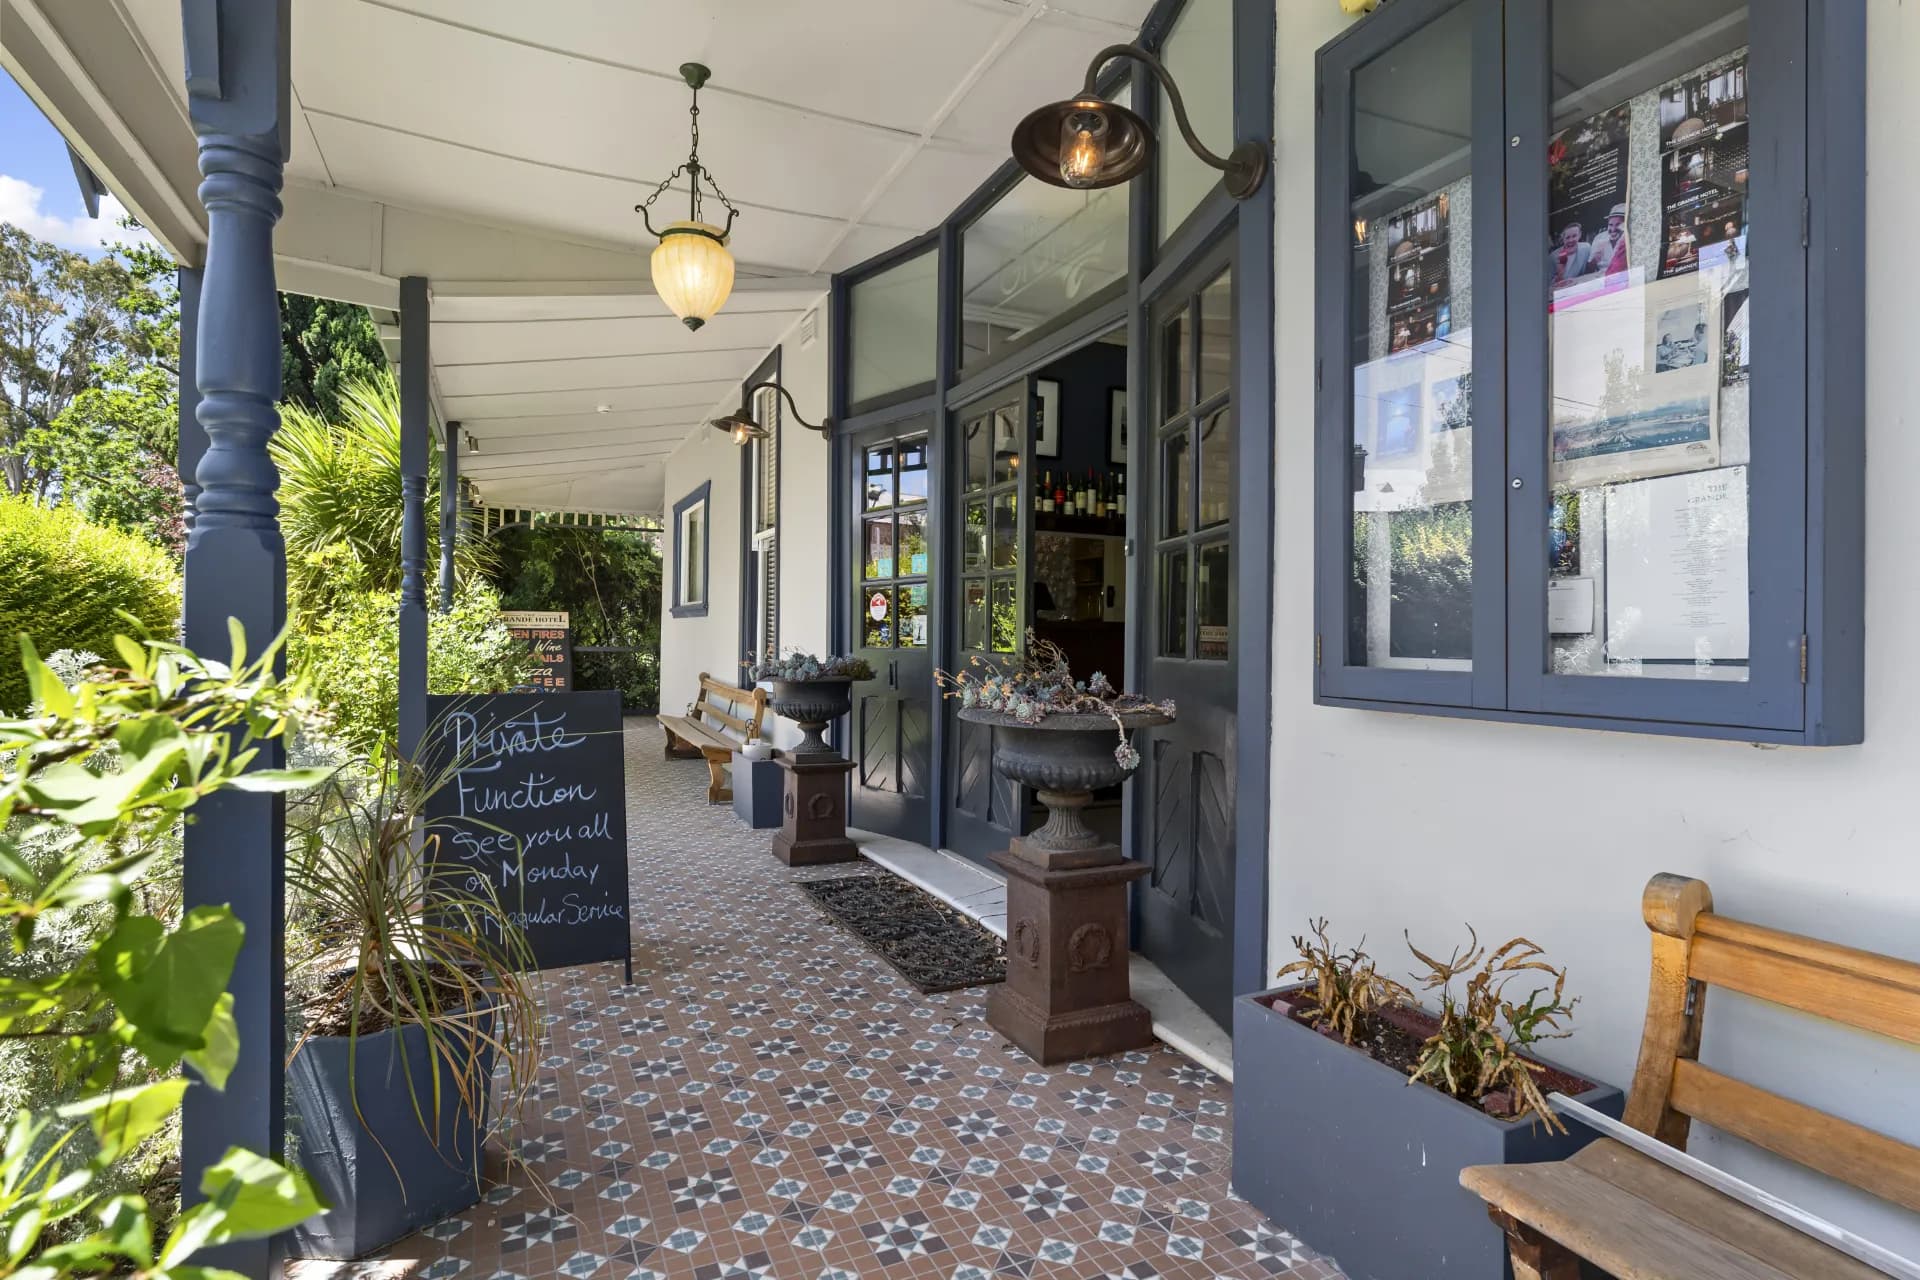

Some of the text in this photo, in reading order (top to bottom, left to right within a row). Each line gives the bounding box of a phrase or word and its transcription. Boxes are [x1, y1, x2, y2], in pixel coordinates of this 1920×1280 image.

[1667, 188, 1719, 211] THE GRANDE HOTEL
[532, 630, 565, 639] FIRES
[535, 614, 566, 623] HOTEL
[534, 639, 563, 653] Wine
[444, 711, 587, 761] Private
[451, 761, 597, 816] Function
[522, 828, 573, 857] you
[578, 813, 613, 841] all
[503, 852, 600, 887] Monday
[562, 892, 625, 925] Service
